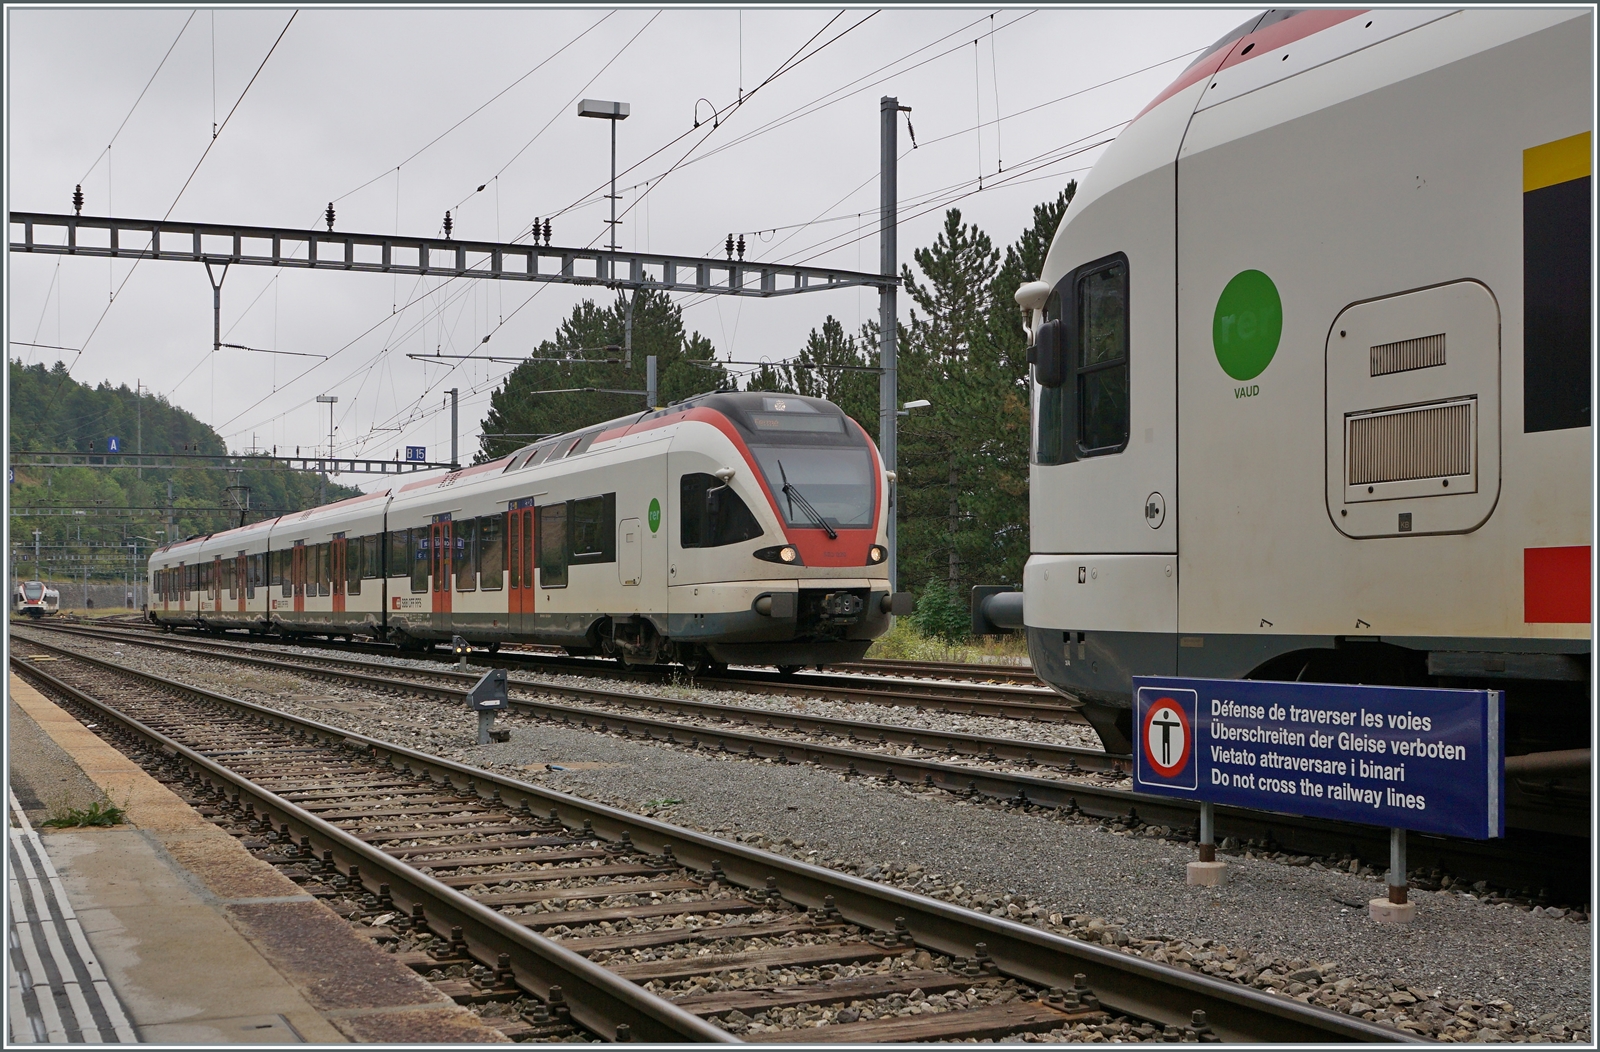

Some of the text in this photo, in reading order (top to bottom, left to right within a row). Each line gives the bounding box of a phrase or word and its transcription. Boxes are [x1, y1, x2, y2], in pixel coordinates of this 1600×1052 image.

[1221, 305, 1274, 344] rer
[1234, 385, 1260, 399] VAUD
[110, 439, 117, 451] A
[406, 448, 425, 459] B 15
[649, 510, 660, 521] rer
[1400, 521, 1410, 529] KB
[1211, 700, 1431, 732] Défense de traverser les voies
[1211, 718, 1466, 761] Überschreiten der Gleise verboten
[1211, 746, 1405, 782] Vietato attraversare i binari
[1211, 768, 1426, 810] Do not cross the railway lines
